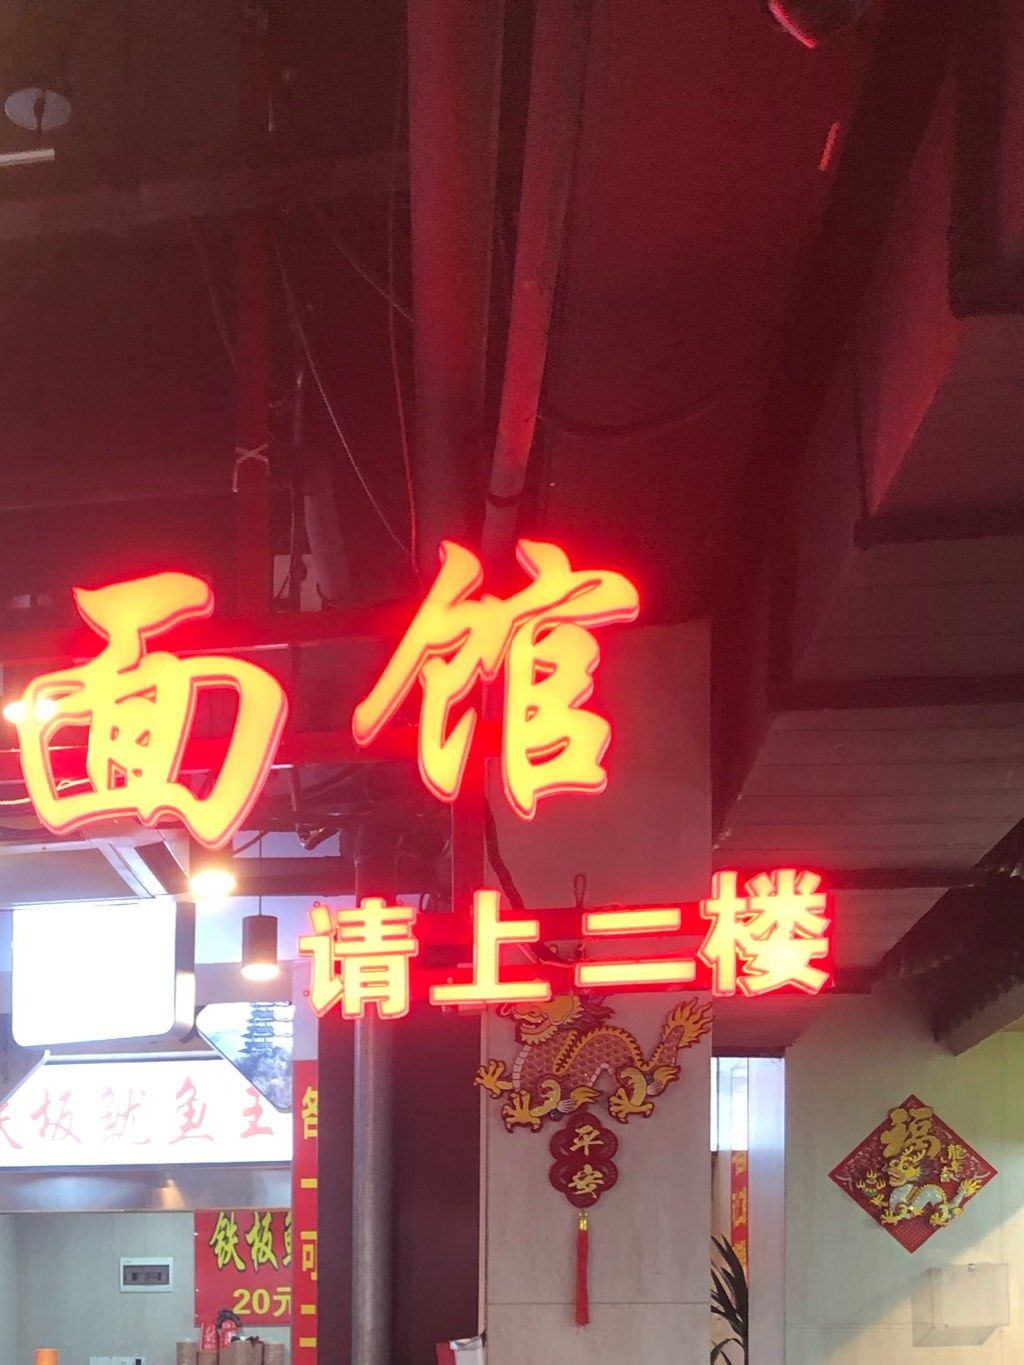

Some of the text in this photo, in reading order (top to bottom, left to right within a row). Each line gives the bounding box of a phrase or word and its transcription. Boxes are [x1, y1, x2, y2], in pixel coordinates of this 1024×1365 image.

[298, 867, 834, 1021] 请上二楼
[568, 1124, 604, 1199] 平安
[881, 1107, 941, 1159] 福
[209, 1211, 291, 1271] 铁板
[232, 1287, 291, 1317] 20元
